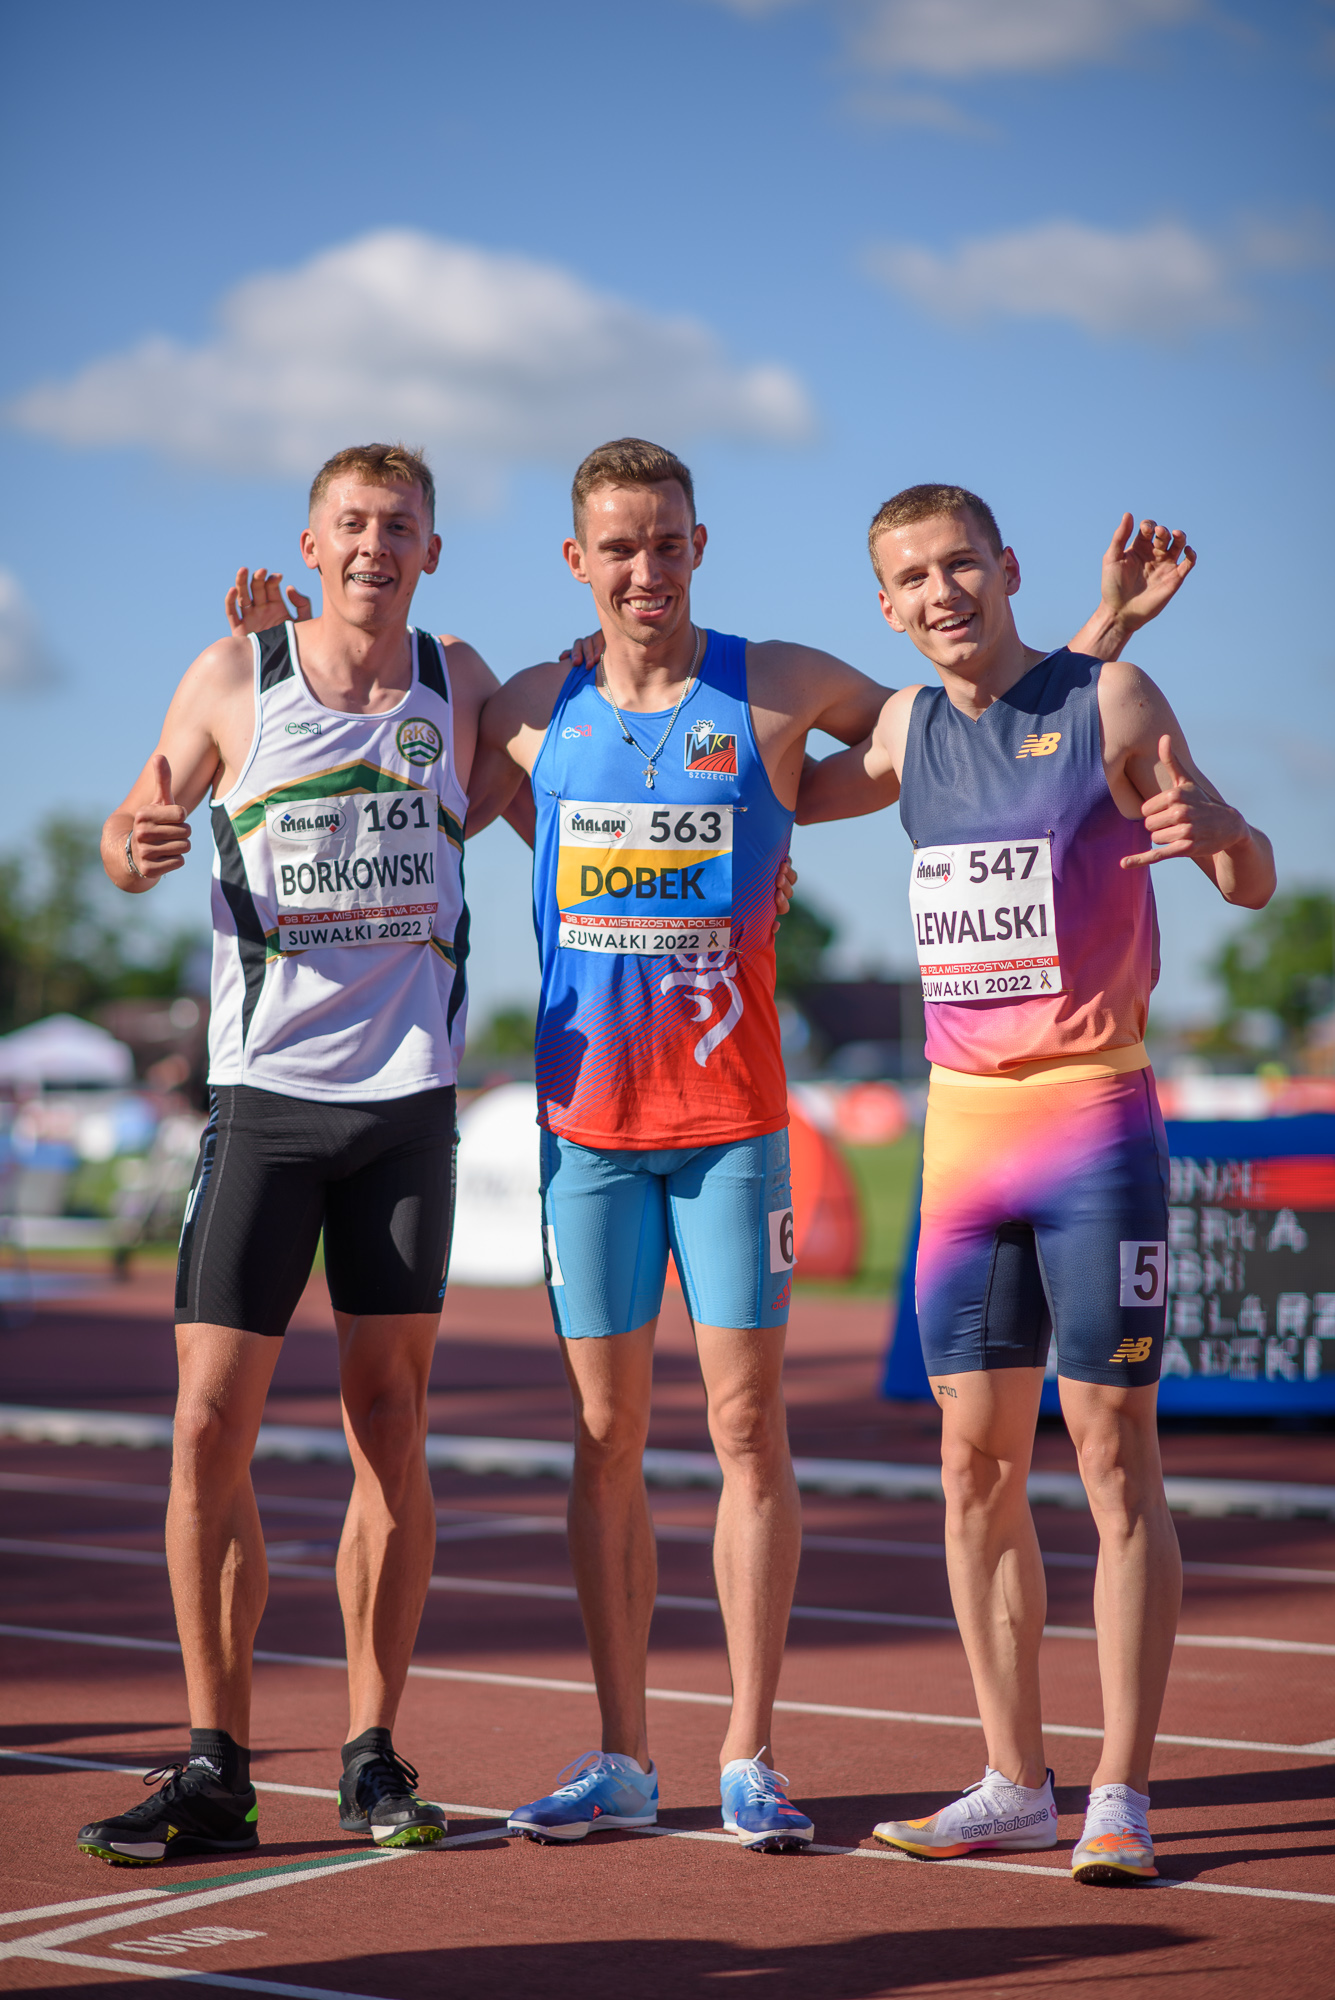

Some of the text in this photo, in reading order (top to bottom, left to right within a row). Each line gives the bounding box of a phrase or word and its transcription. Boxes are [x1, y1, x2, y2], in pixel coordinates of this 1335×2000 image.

[403, 725, 436, 745] RKS
[562, 724, 592, 739] esa
[689, 771, 735, 782] SZCZECIN
[364, 796, 430, 832] 161
[650, 811, 722, 843] 563
[280, 852, 435, 896] BORKOWSKI
[969, 845, 1040, 884] 547
[580, 865, 706, 900] DOBEK
[284, 903, 437, 924] 98. PZLA MISTRZOSTWA POLSKI
[565, 914, 726, 928] 98. PZLA MISTRZOSTWA POLSKI
[916, 903, 1048, 946] LEWALSKI
[288, 920, 422, 946] SUWAŁKI 2022
[567, 929, 700, 950] SUWAŁKI 2022
[928, 966, 944, 975] PZLA
[944, 961, 1015, 974] MISTRZOSTWA
[1016, 957, 1054, 968] POLSKI
[923, 975, 1033, 997] SUWAŁKI 2022
[780, 1211, 793, 1264] 6
[1133, 1246, 1159, 1301] 5
[937, 1385, 958, 1399] run
[961, 1807, 1049, 1840] new balance
